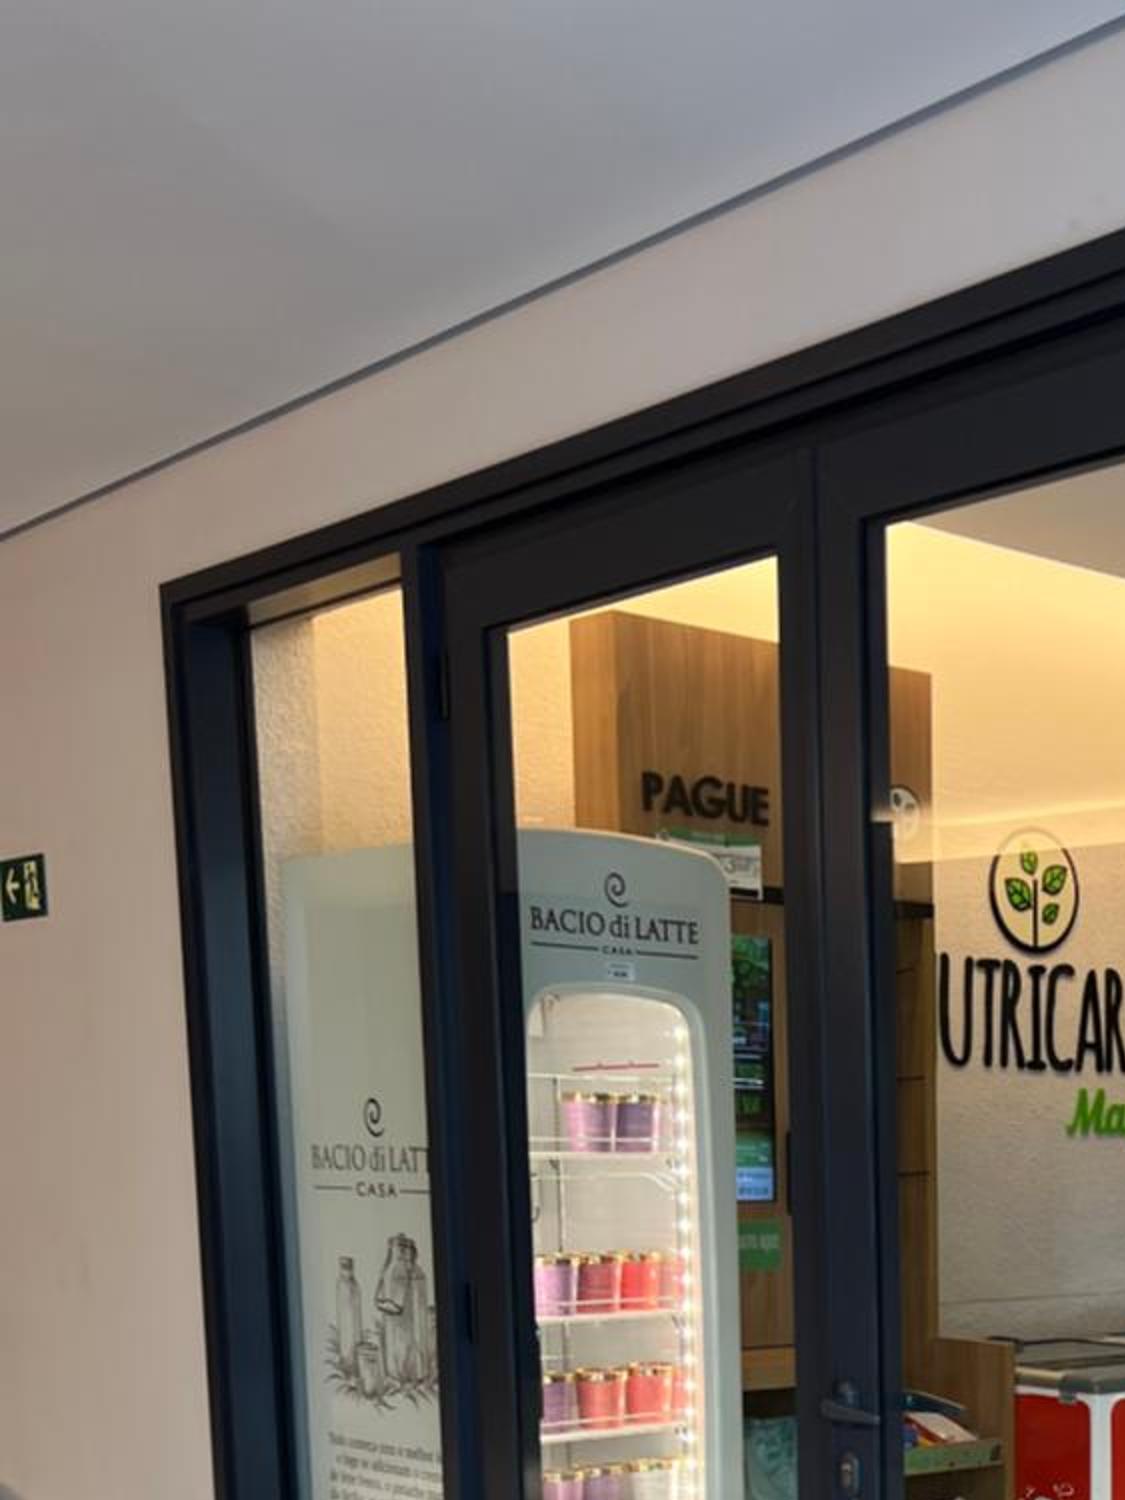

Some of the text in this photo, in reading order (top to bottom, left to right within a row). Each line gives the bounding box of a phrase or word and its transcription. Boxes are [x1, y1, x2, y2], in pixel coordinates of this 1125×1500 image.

[641, 770, 769, 827] PAGUE
[529, 906, 700, 945] BACIO di LATTE
[311, 1143, 367, 1171] BACIO
[369, 1146, 386, 1173] di
[355, 1181, 398, 1198] CASA
